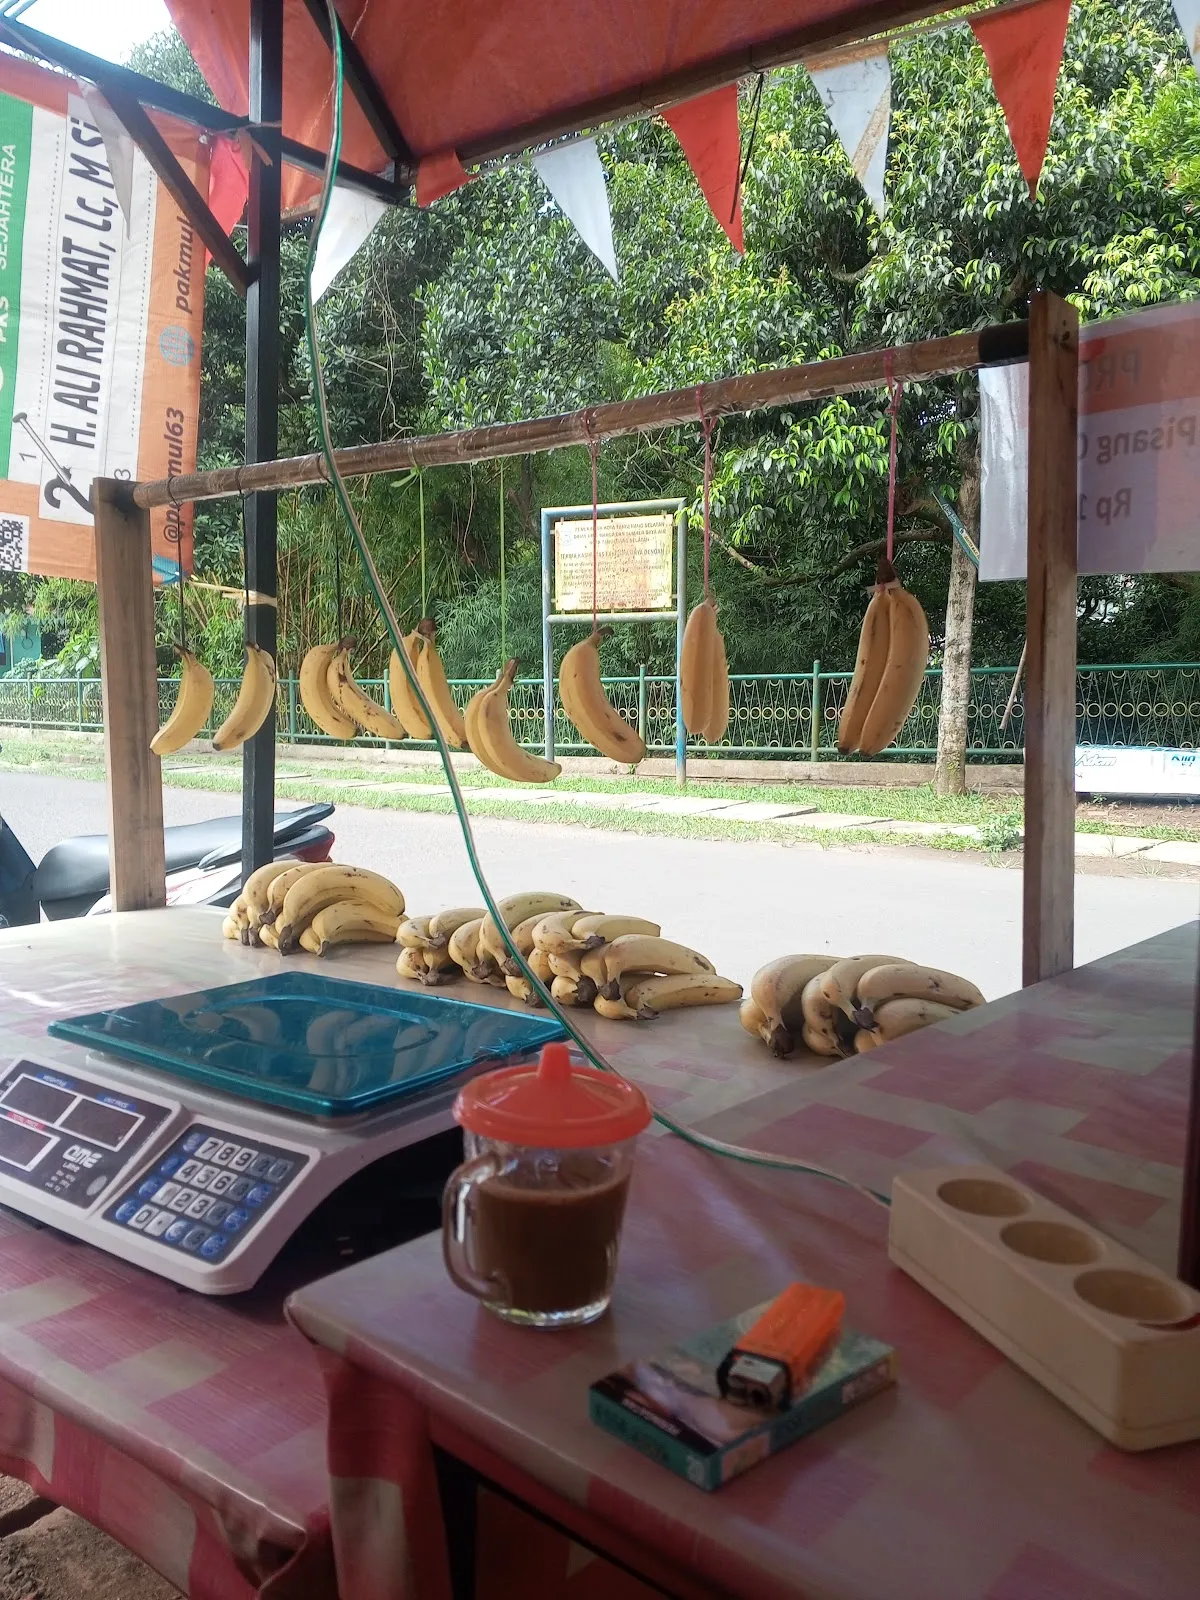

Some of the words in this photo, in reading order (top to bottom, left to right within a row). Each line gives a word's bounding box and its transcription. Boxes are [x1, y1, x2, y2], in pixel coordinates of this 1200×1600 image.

[57, 237, 116, 363] RAHMAT,
[53, 363, 101, 414] ALI
[50, 422, 97, 449] H.
[44, 472, 95, 515] 2
[201, 1141, 218, 1153] 7
[218, 1147, 234, 1160] 8
[235, 1152, 251, 1166] 9
[182, 1164, 197, 1178] 4
[216, 1175, 231, 1189] 6
[176, 1193, 192, 1207] 2
[192, 1200, 208, 1213] 3
[135, 1210, 153, 1224] 0
